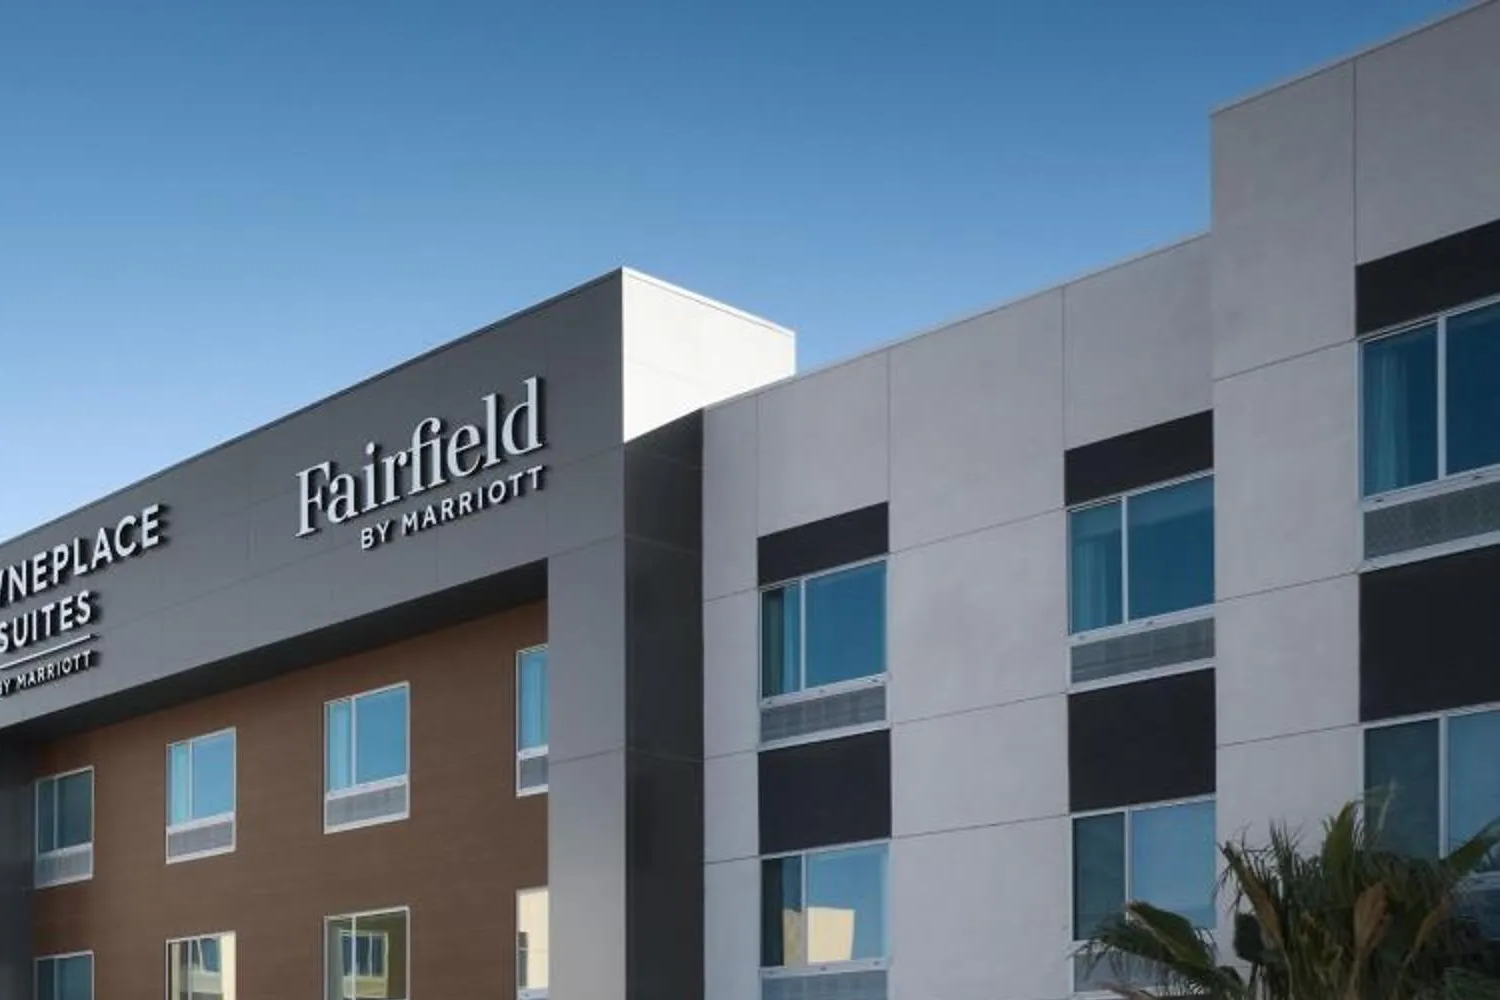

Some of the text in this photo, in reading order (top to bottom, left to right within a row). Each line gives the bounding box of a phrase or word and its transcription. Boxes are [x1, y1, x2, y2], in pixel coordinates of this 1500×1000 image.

[295, 375, 544, 537] Fairfield
[360, 464, 544, 550] BY MARRIOTT
[16, 649, 92, 688] MARRIOTT
